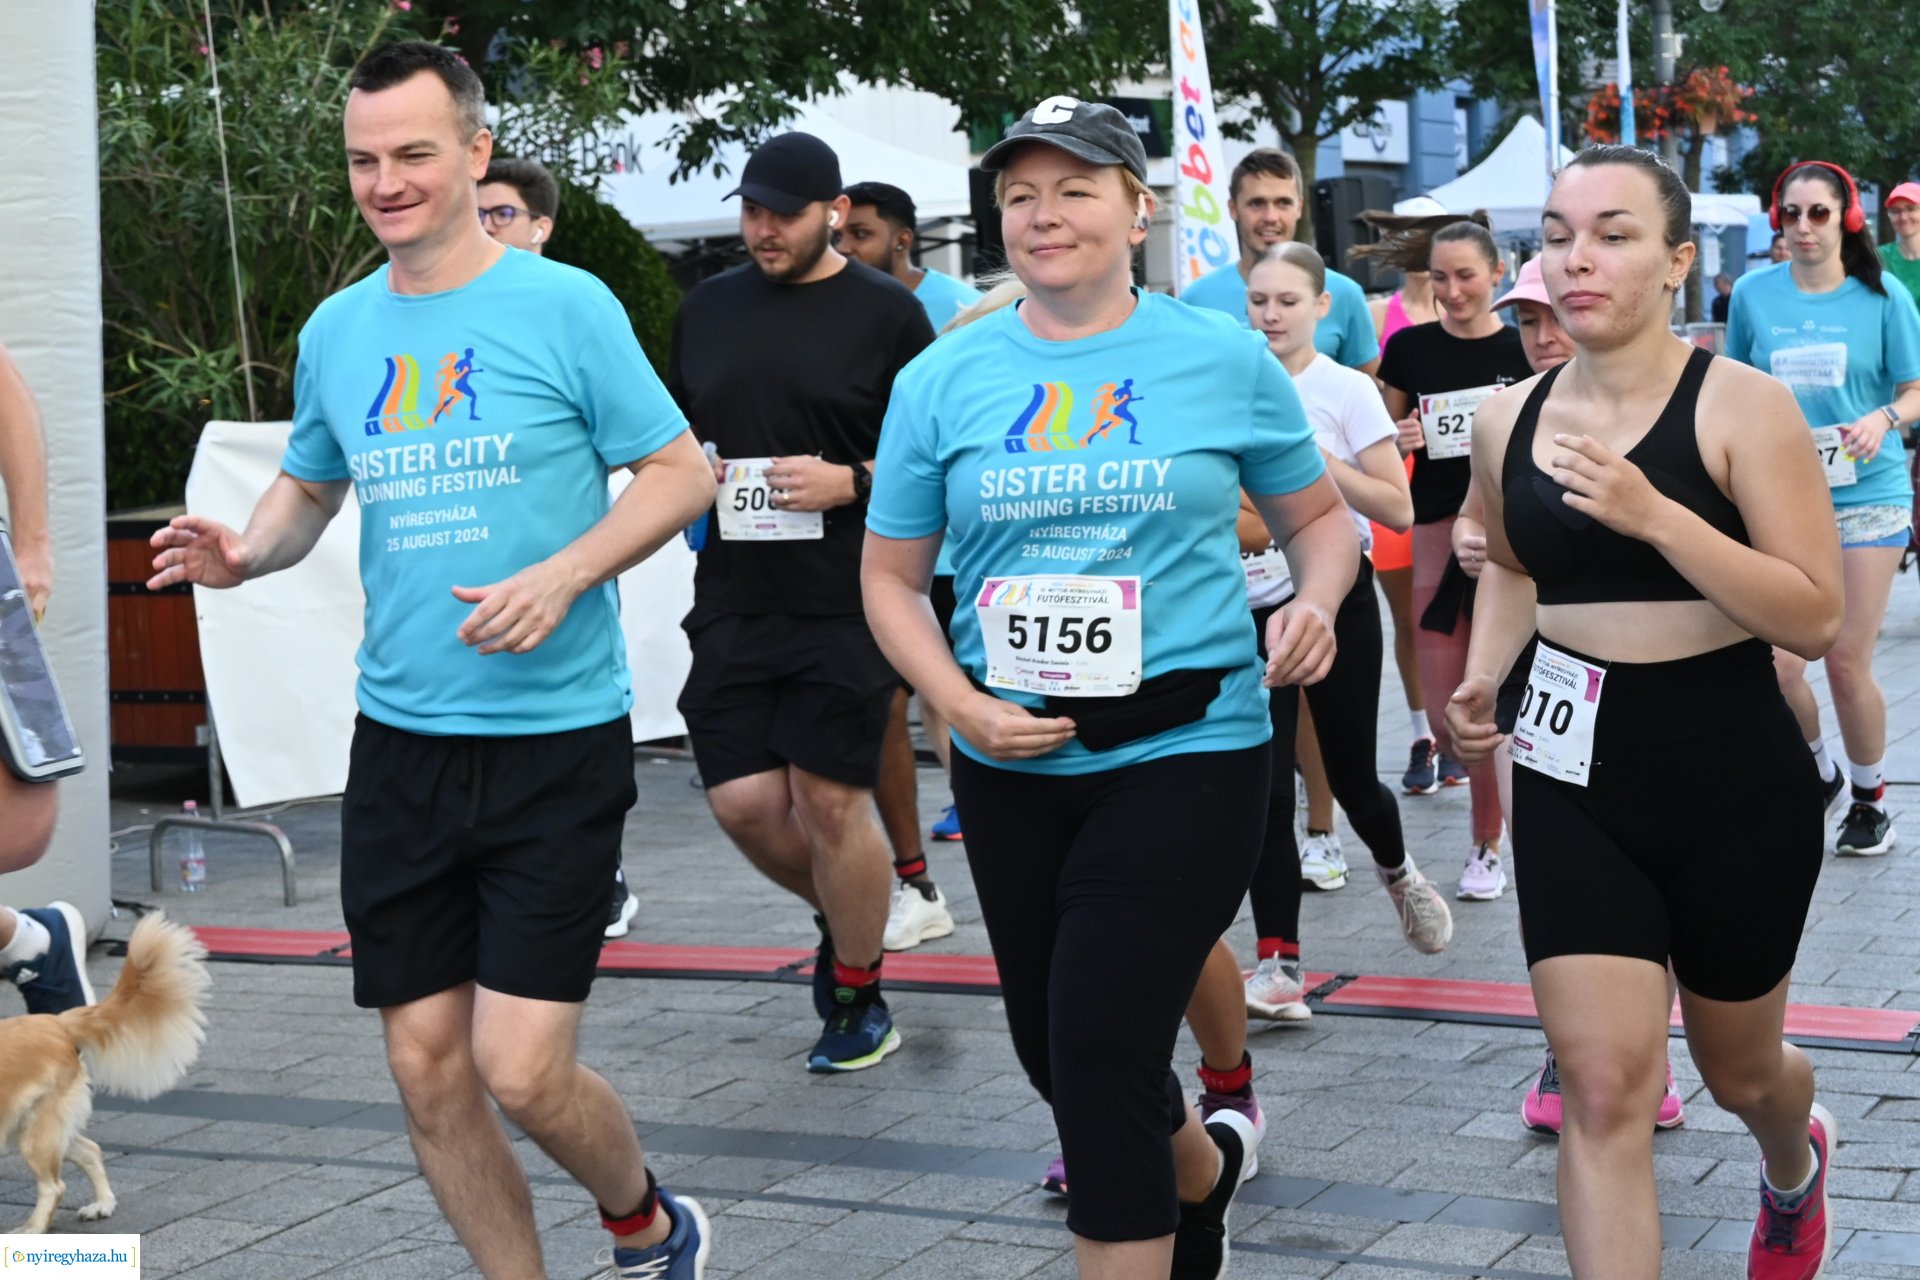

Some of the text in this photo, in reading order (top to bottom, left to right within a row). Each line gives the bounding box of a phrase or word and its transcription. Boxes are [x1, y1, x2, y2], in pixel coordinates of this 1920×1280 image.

[582, 132, 643, 174] Bank
[1437, 411, 1475, 436] 52
[350, 432, 514, 481] SISTER CITY
[1818, 446, 1838, 465] 7
[432, 465, 521, 495] FESTIVAL
[980, 458, 1172, 499] SISTER CITY
[390, 504, 477, 530] NYÍREGYHÁZA
[981, 492, 1177, 523] RUNNING FESTIVAL
[386, 525, 489, 552] 25 AUGUST 2024
[1029, 523, 1128, 541] NYÍREGYHÁZA
[1021, 544, 1133, 562] 25 AUGUST 2024
[1036, 594, 1110, 604] FUTÓFESZTIVÁL
[1008, 614, 1112, 654] 5156
